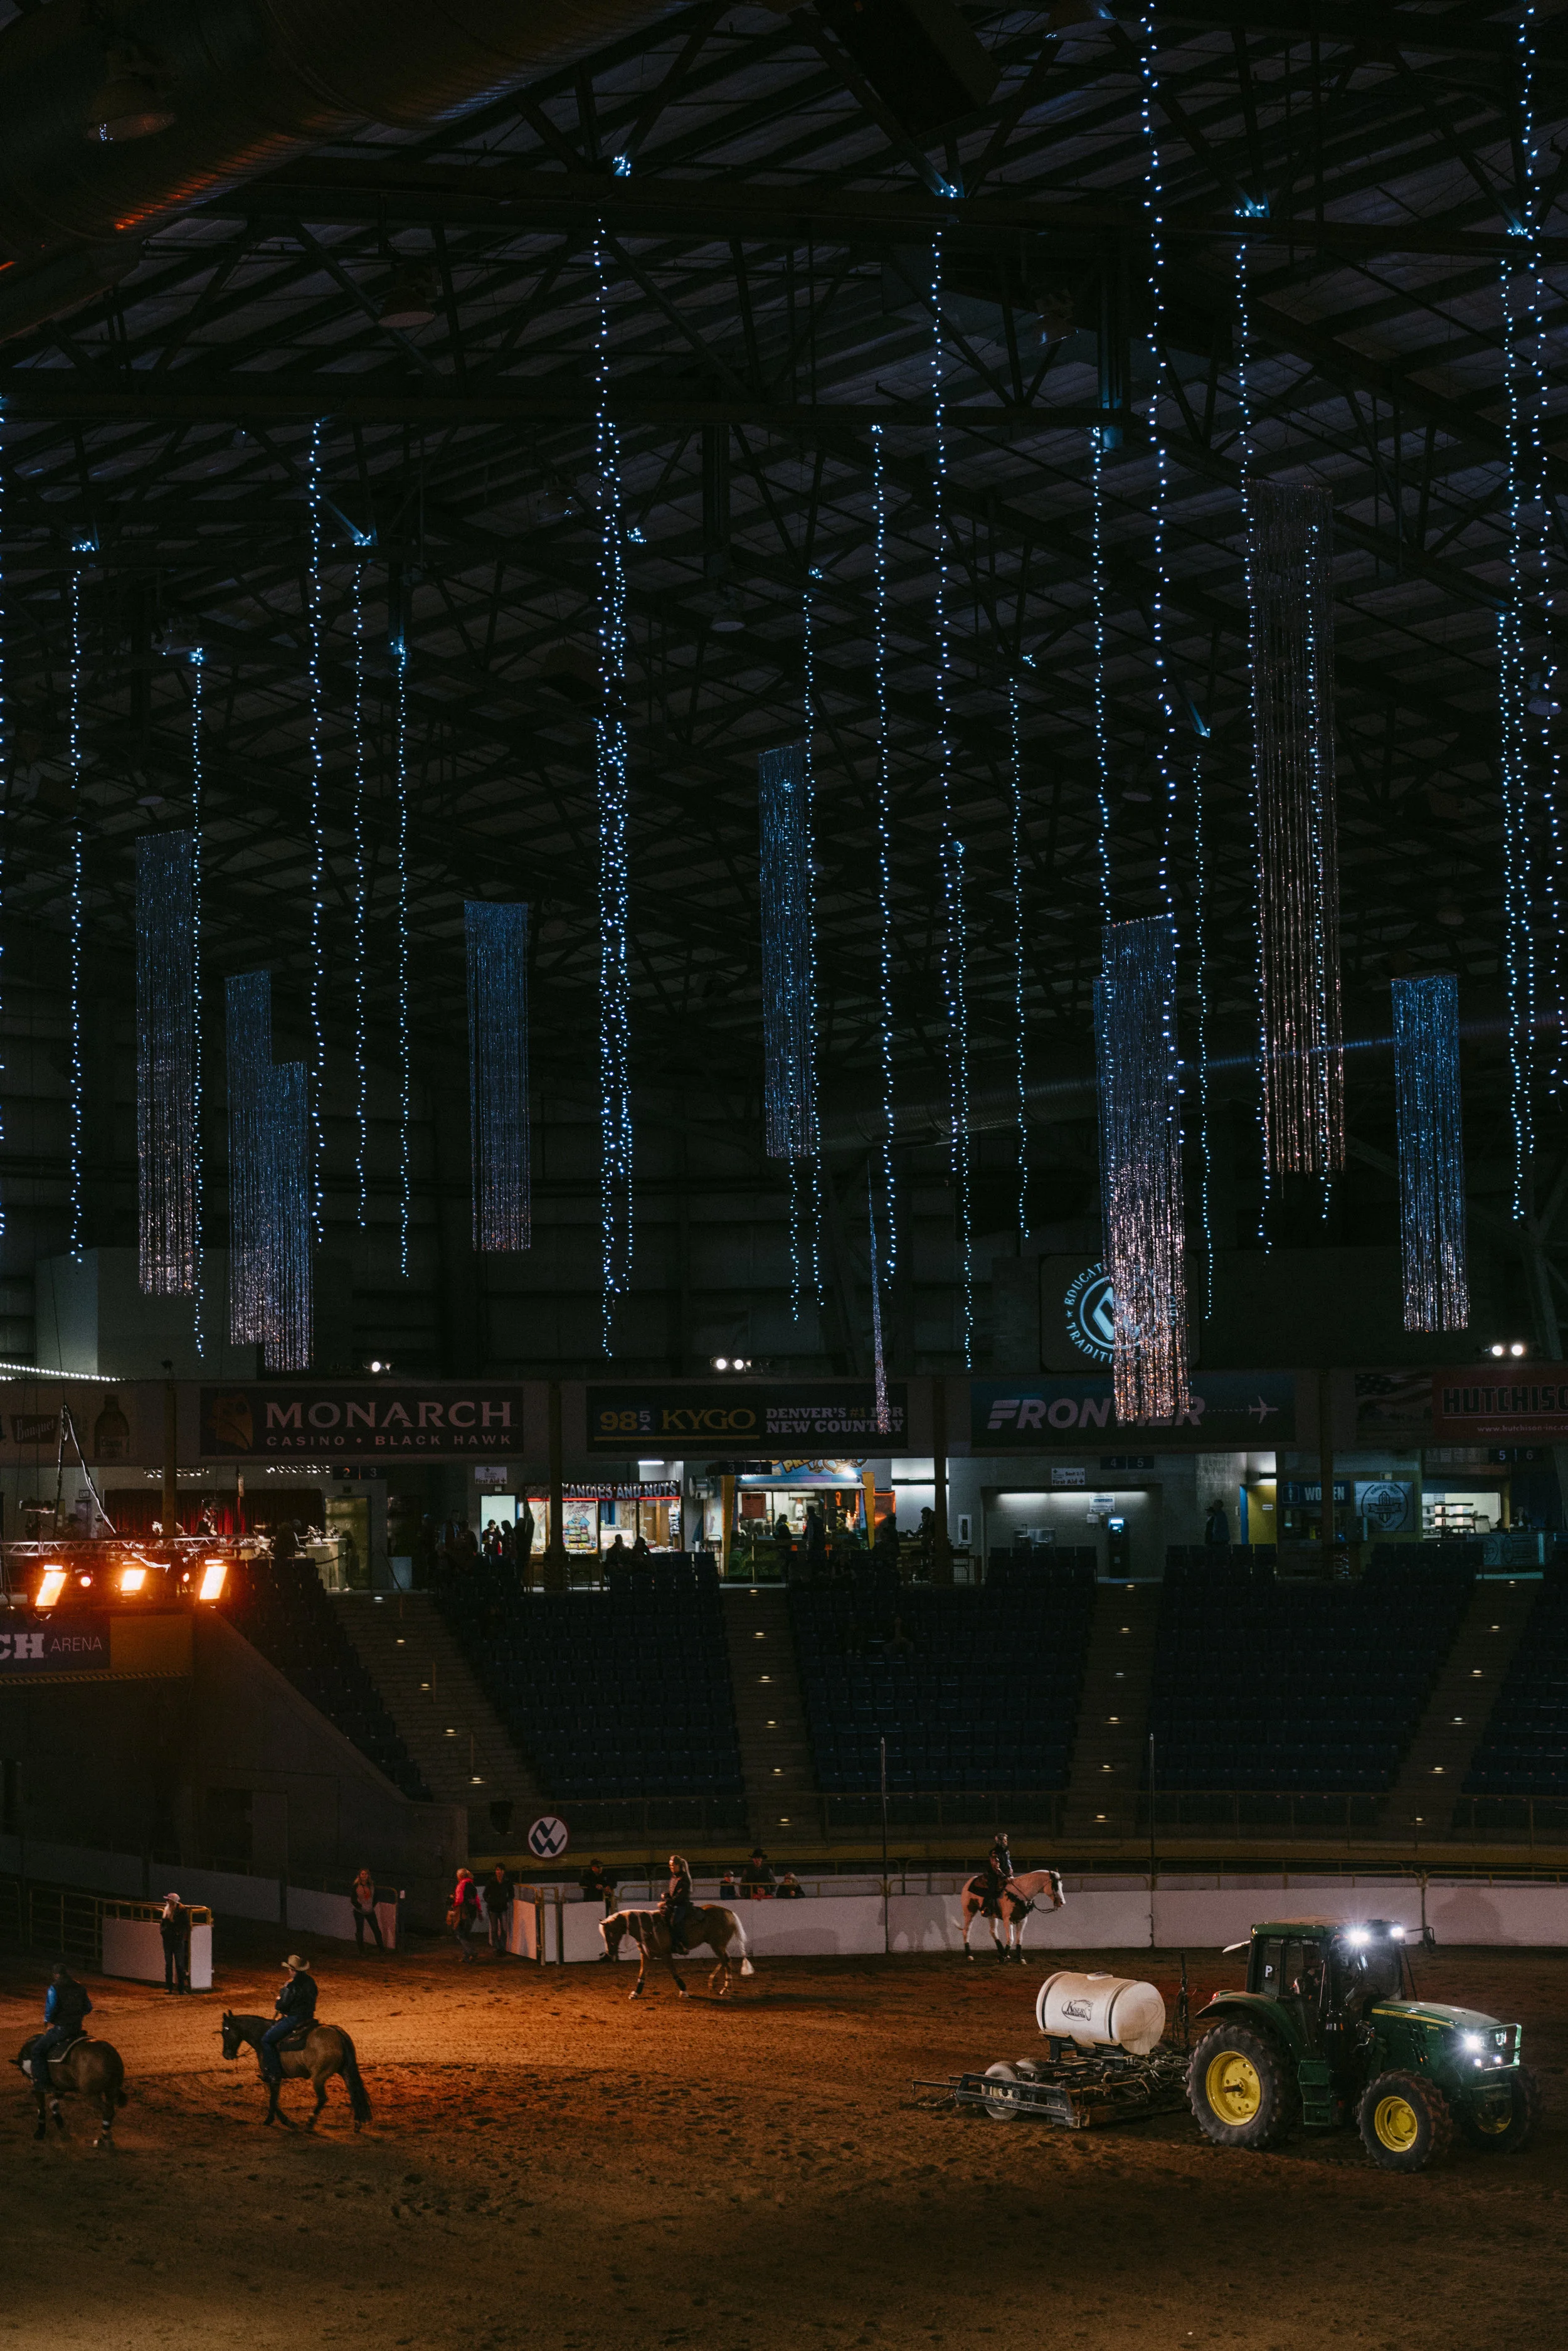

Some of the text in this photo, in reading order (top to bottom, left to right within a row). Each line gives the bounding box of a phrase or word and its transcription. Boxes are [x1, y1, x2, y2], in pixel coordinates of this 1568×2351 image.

[266, 1401, 511, 1428] MONARCH
[660, 1408, 756, 1430] KYGO
[766, 1408, 847, 1418] DENVER'S
[871, 1407, 904, 1417] FR
[987, 1396, 1206, 1430] FRONR
[766, 1420, 904, 1433] NEW COUNTY
[267, 1434, 511, 1446] CASINO BLACK HAWK
[1498, 1450, 1533, 1460] 5 6
[1110, 1458, 1145, 1467] 4 5
[343, 1467, 376, 1477] 2 3
[562, 1482, 613, 1499] CANDIES
[617, 1482, 641, 1498] AND
[644, 1480, 678, 1497] NUTS
[1305, 1485, 1345, 1501] WOEN
[50, 1636, 103, 1653] ARENA
